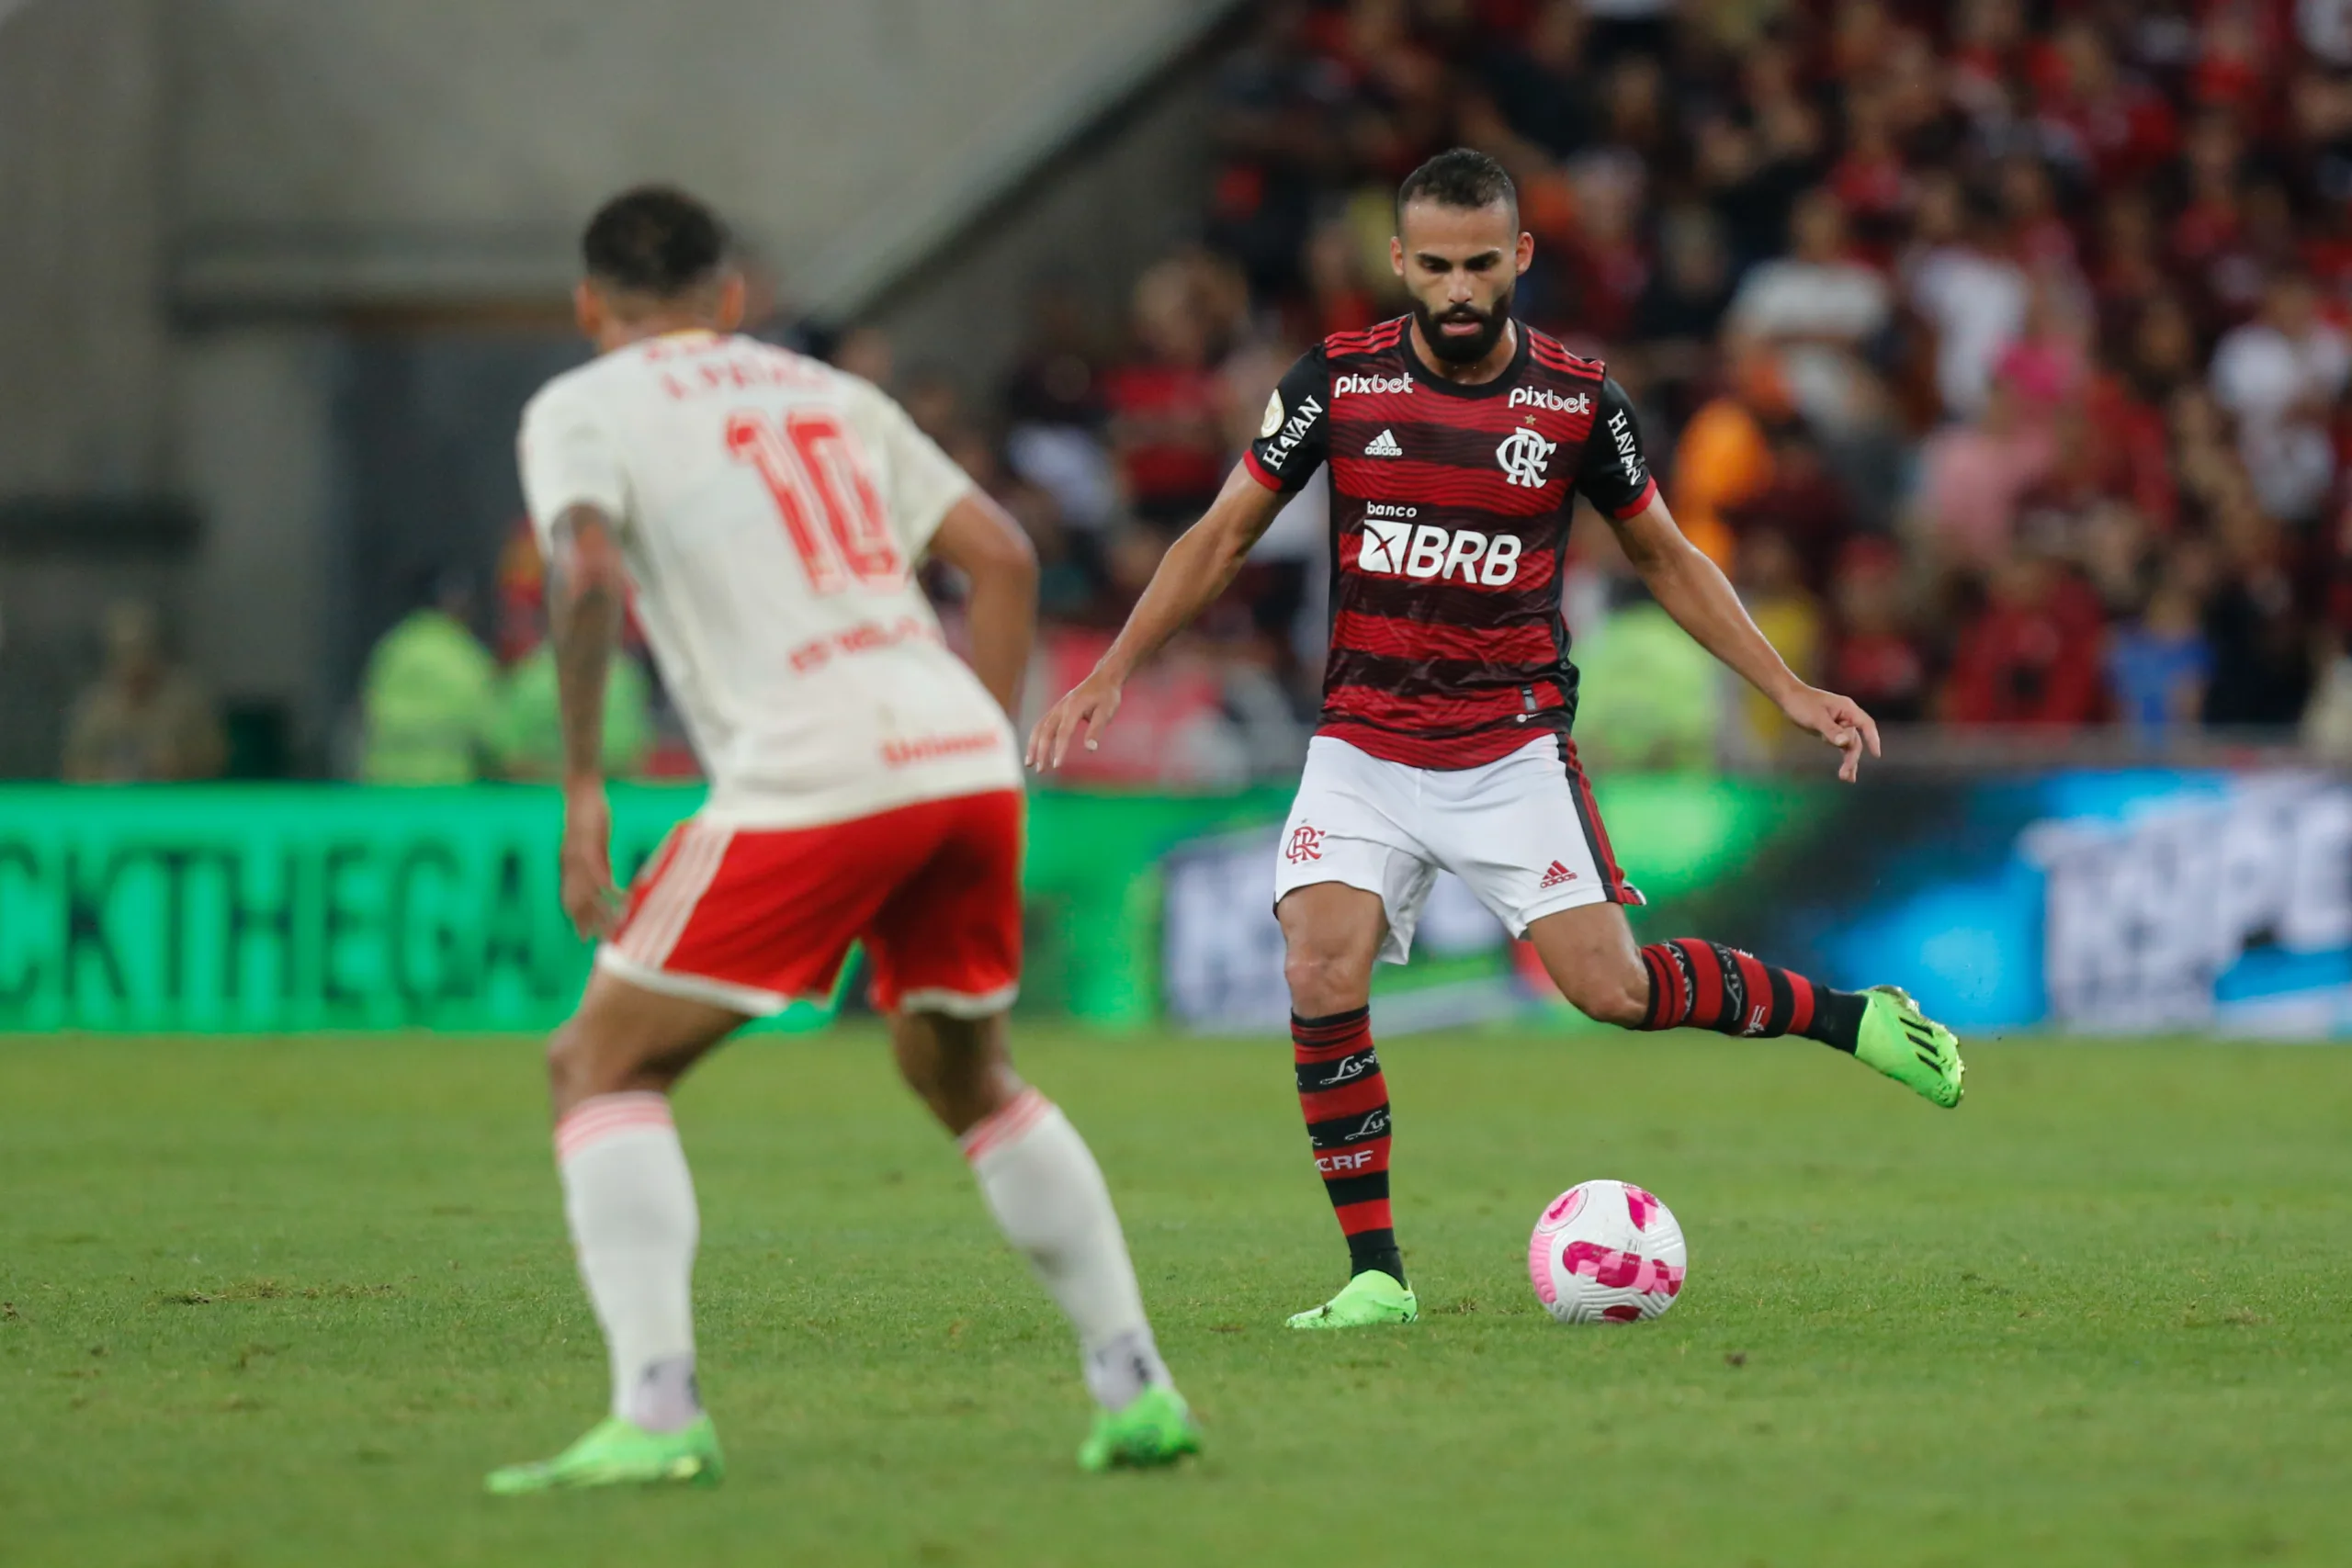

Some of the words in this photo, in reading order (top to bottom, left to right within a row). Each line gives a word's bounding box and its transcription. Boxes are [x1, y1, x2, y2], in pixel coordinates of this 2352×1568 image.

[1333, 371, 1414, 399] pixbet
[1507, 385, 1590, 415] pixbet
[1261, 394, 1324, 470] HAVAN
[1363, 446, 1403, 457] adidas
[724, 407, 907, 595] 10
[1366, 501, 1418, 518] banco
[1406, 525, 1522, 586] BRB
[1540, 872, 1577, 889] adidas
[0, 841, 649, 1003] CKTHEGA
[1315, 1149, 1374, 1172] CRF
